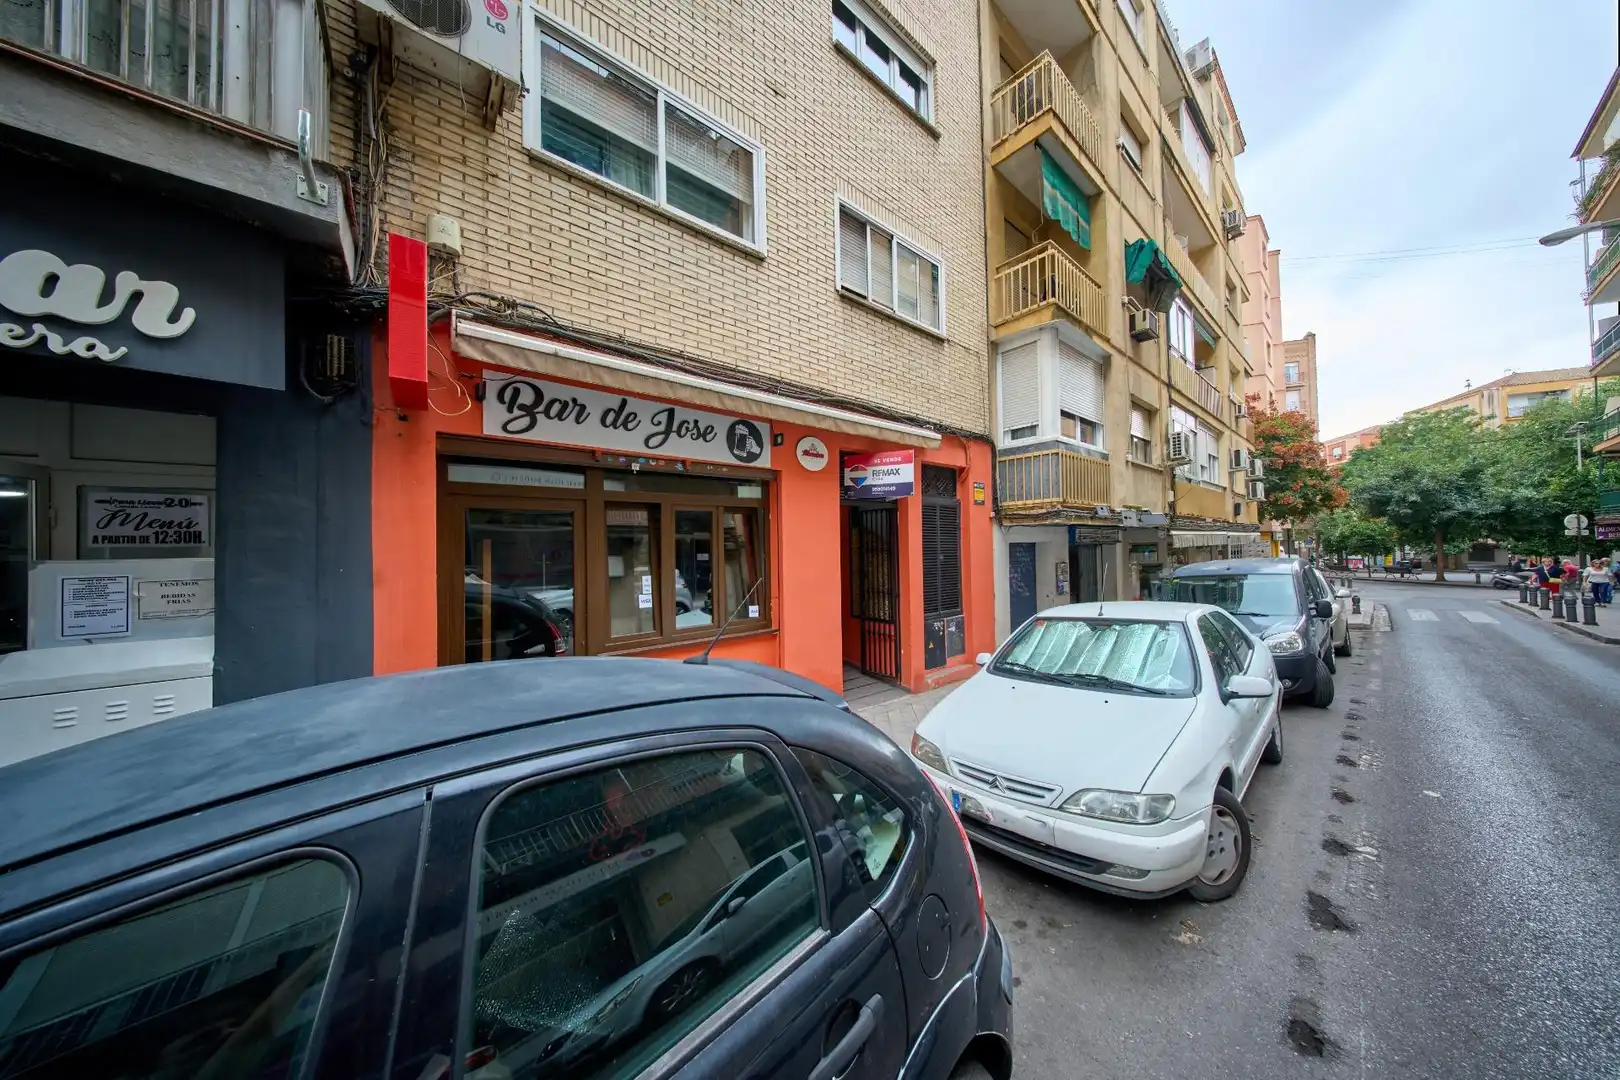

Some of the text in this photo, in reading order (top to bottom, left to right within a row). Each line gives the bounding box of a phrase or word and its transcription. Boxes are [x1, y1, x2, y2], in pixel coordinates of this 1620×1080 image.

[486, 15, 506, 35] LG
[497, 380, 718, 450] Bar de Jose
[96, 508, 199, 531] Menú
[92, 530, 206, 545] A PARTIR DE 12:30H.
